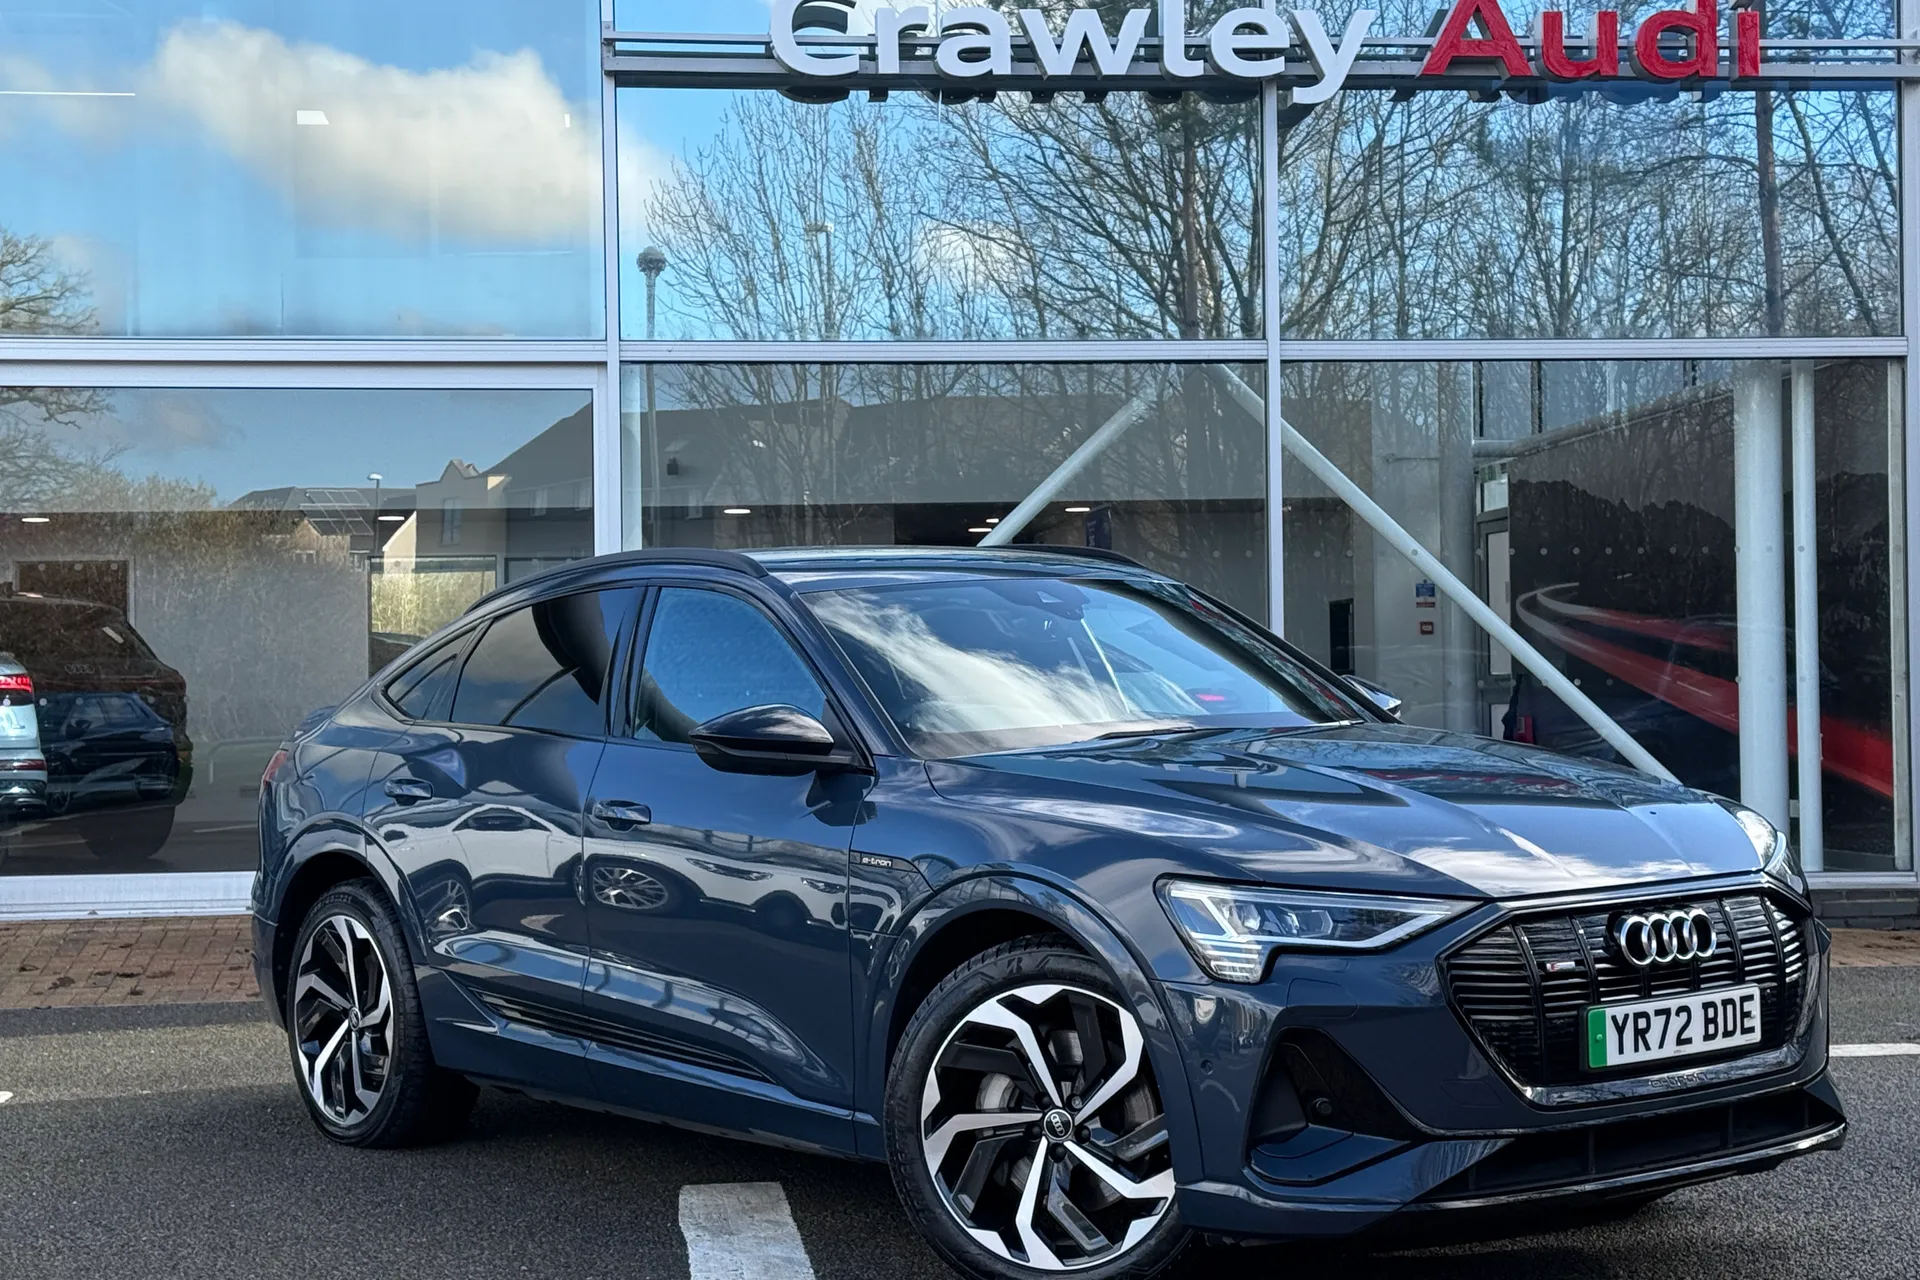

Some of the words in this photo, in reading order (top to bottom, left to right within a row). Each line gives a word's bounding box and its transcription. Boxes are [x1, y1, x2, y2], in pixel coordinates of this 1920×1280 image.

[769, 0, 1375, 105] Crawley
[1417, 0, 1761, 80] Audi
[862, 857, 892, 867] e-tron
[1611, 1005, 1693, 1055] YR72
[1702, 994, 1755, 1042] BDE
